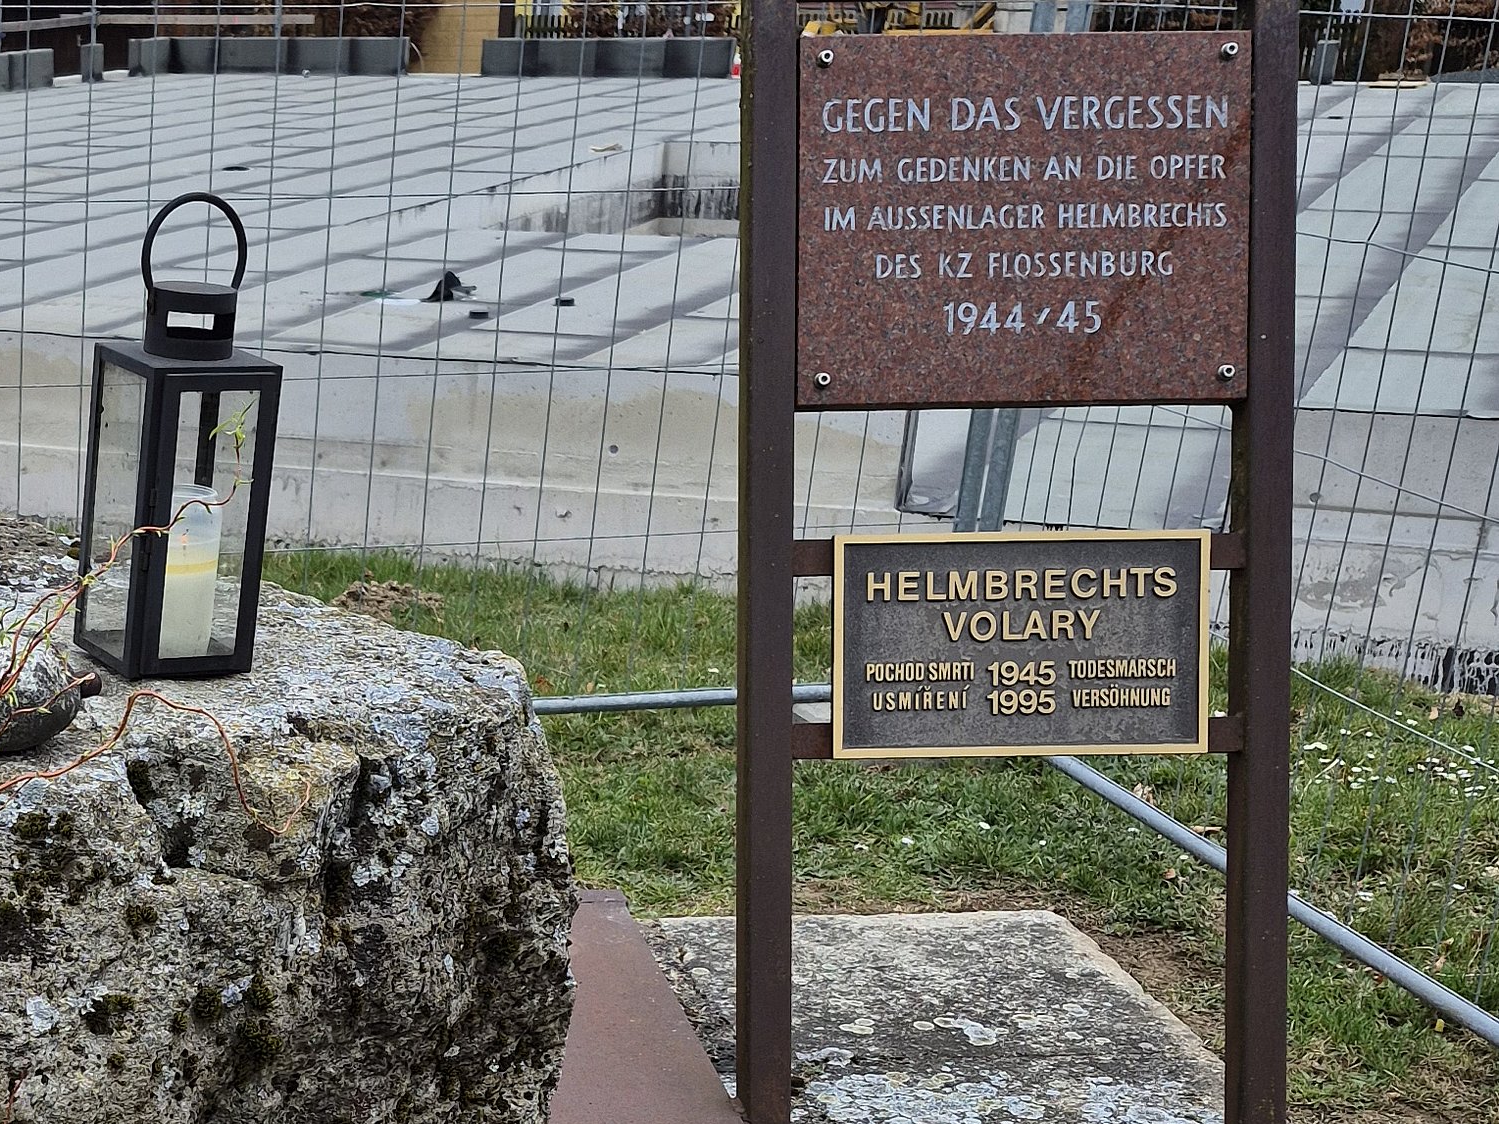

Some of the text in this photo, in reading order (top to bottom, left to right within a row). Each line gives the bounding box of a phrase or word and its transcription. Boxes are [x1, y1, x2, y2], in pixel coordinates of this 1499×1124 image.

[822, 95, 1229, 133] GEGEN DAS VERGESSEN
[822, 154, 1227, 184] ZUM GEDENKEN AN DIE OPFER
[824, 202, 1228, 233] IM AUSSENLAGER HELMBRECHTS
[875, 250, 1174, 280] DES KZ FLOSSENBURG
[866, 567, 1178, 602] HELMBRECHTS
[943, 609, 1101, 642] VOLARY
[865, 658, 1177, 687] POCHOD SMRTI 1945 TODESMARSCH
[872, 684, 1171, 715] USMÍŘENÍ 1995 VERSÖHNUNG
